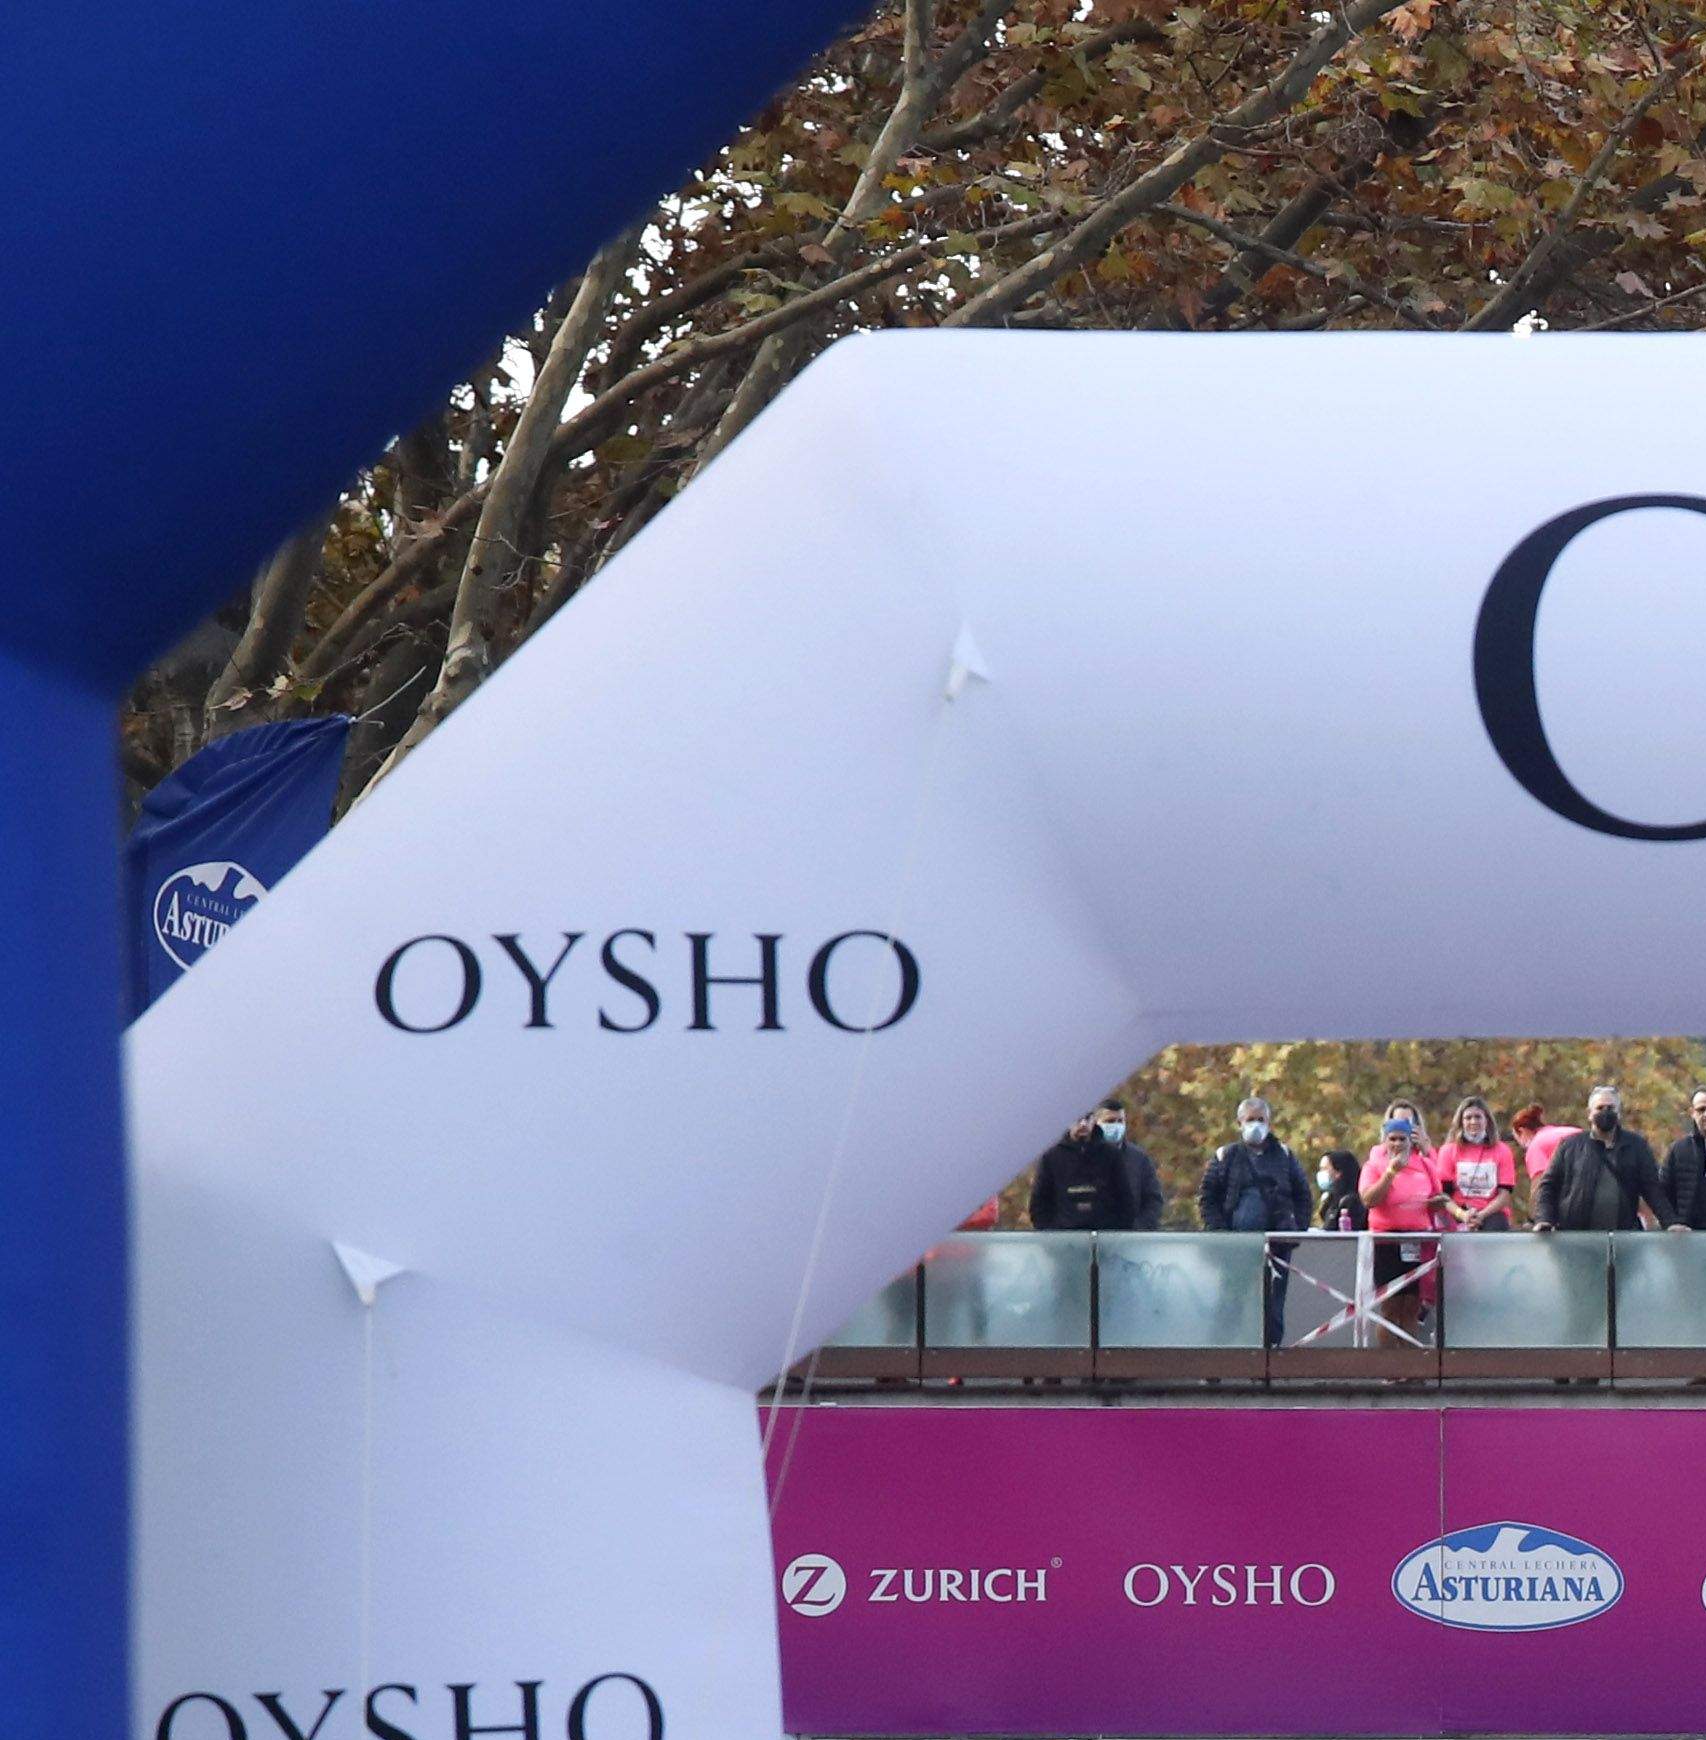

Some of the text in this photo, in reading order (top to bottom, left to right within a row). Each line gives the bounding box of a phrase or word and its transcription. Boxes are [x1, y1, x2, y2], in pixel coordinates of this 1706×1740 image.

[374, 929, 920, 1034] OYSHO
[1124, 1563, 1335, 1607] OYSHO
[1412, 1562, 1604, 1602] ASTURIANA
[1445, 1560, 1598, 1571] CENTRAL LECHERA
